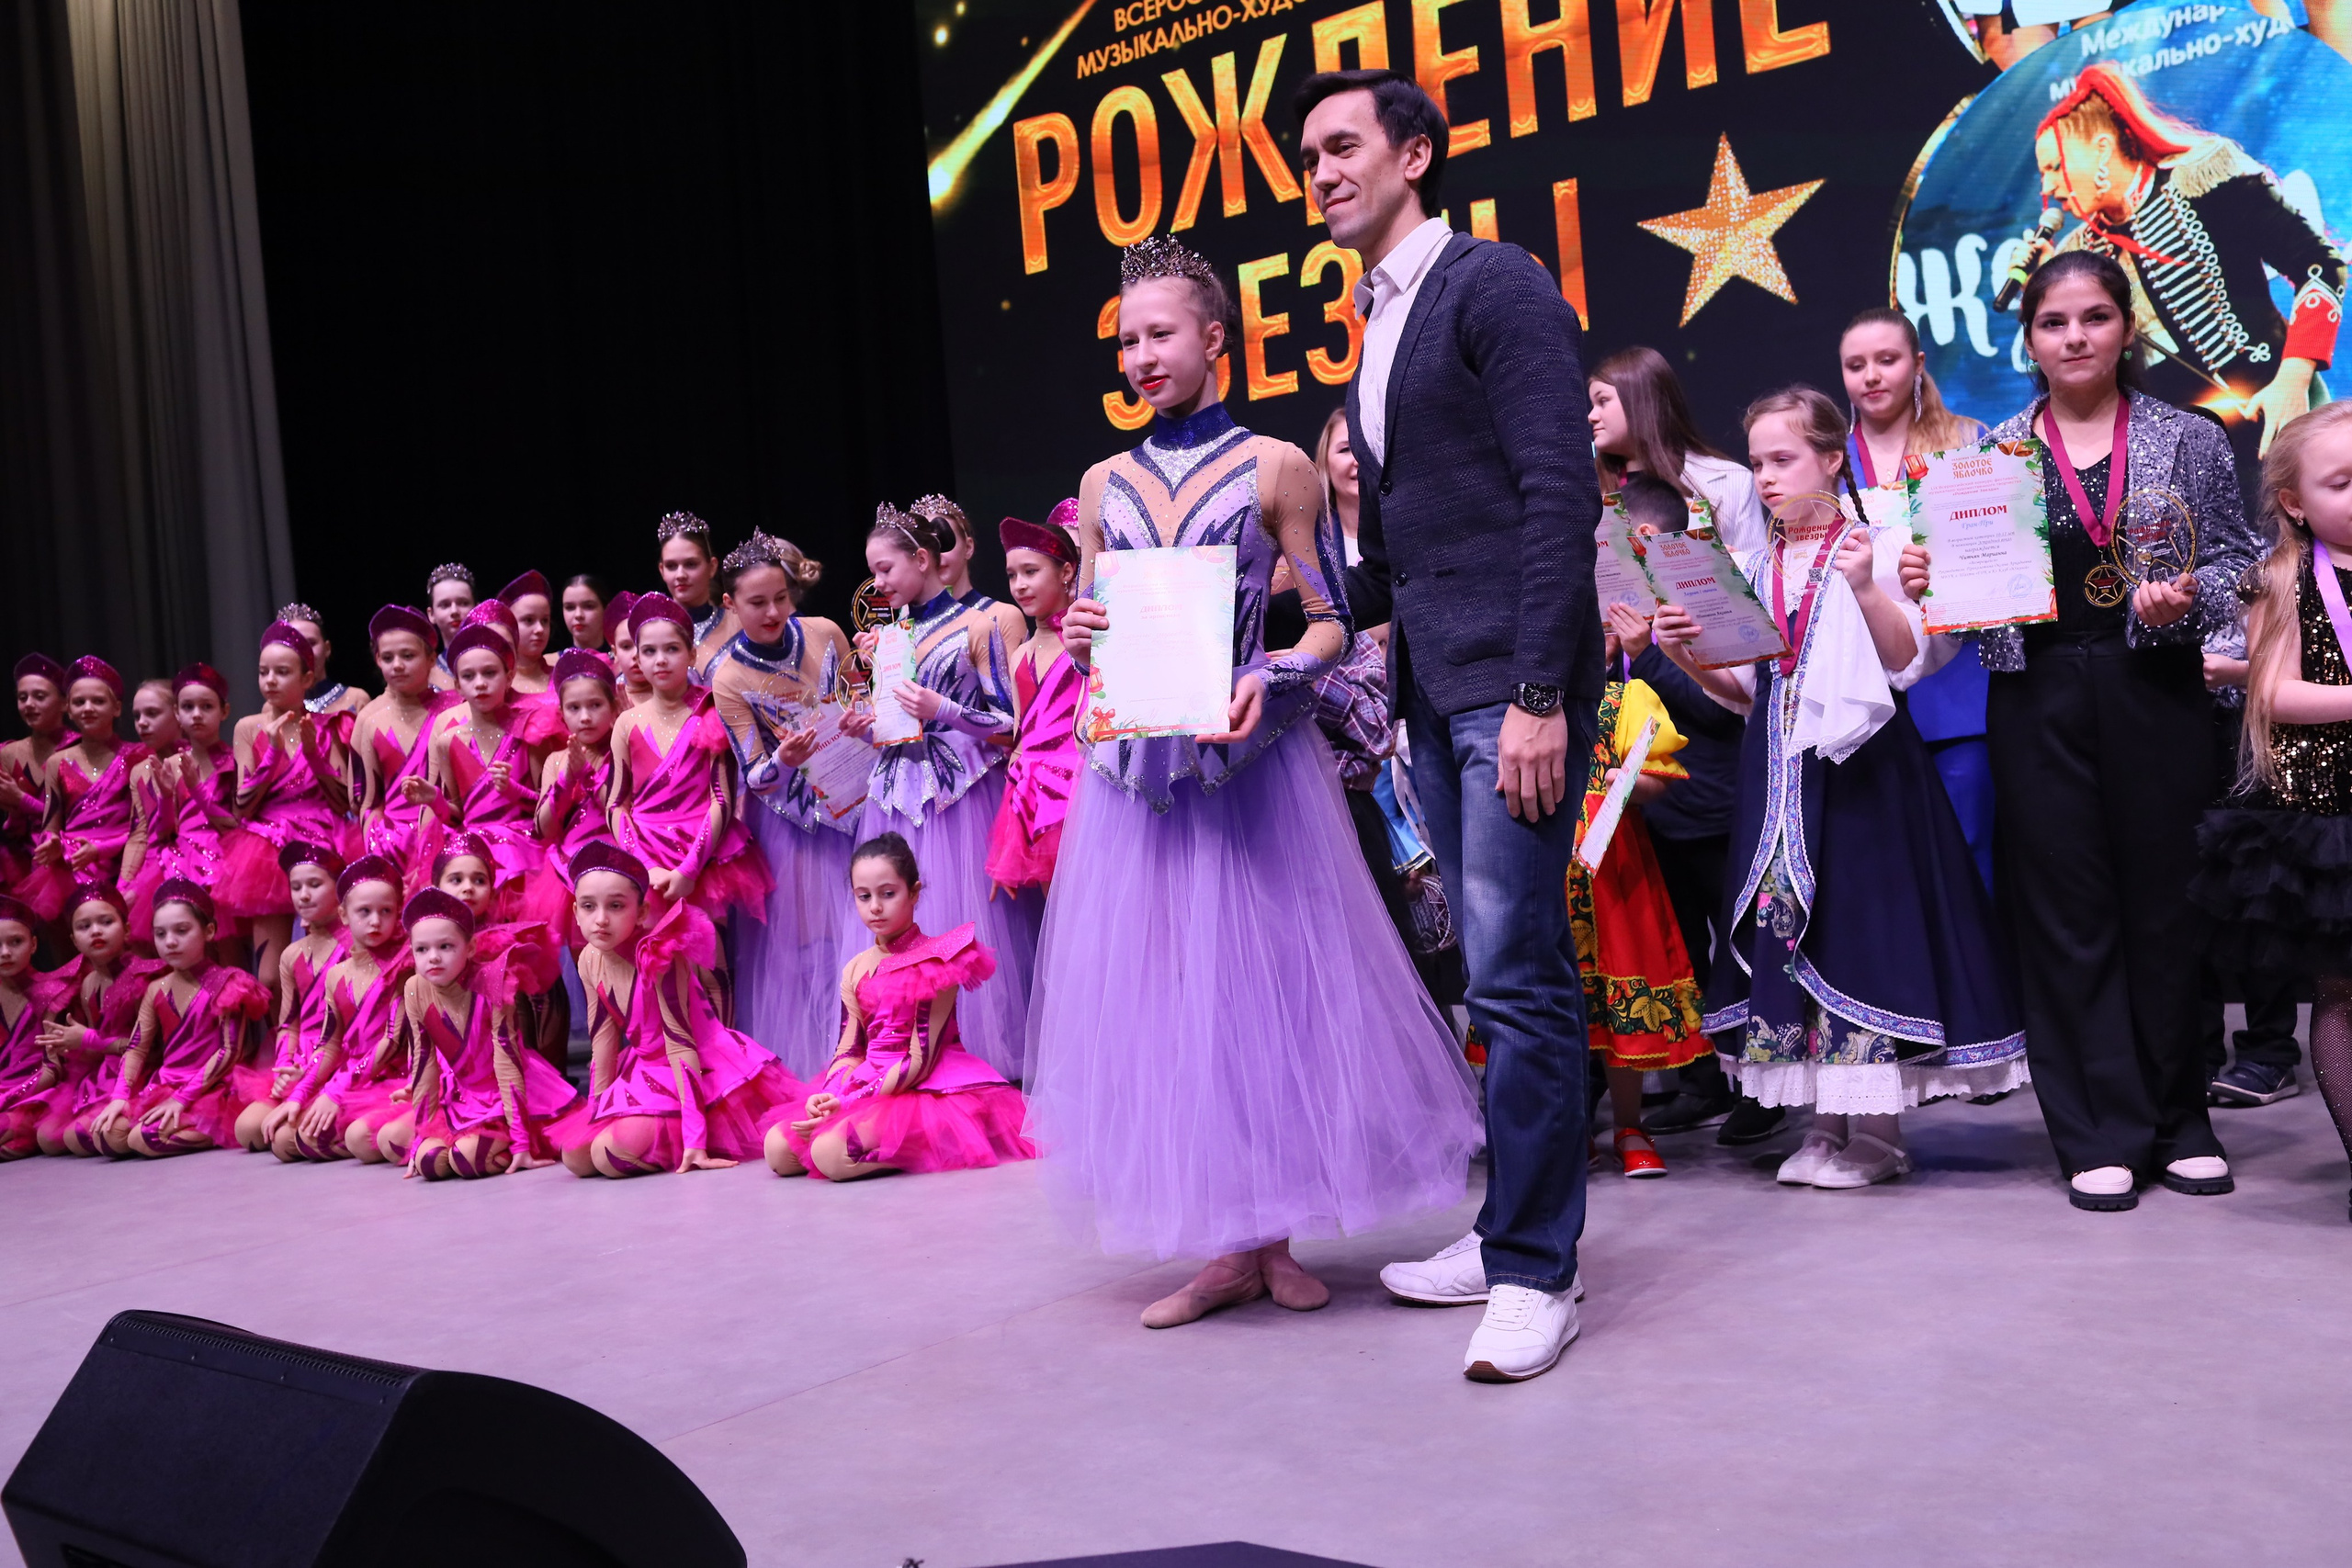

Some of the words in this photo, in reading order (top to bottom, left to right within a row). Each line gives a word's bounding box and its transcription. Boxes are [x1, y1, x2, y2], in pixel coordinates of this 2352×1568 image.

[1953, 467, 1994, 479] ЯБЛОЧКО
[1949, 504, 2007, 522] ДИПЛОМ
[1788, 524, 1833, 535] Рождение
[1795, 533, 1827, 541] звезды
[1676, 577, 1716, 590] ДИПЛОМ
